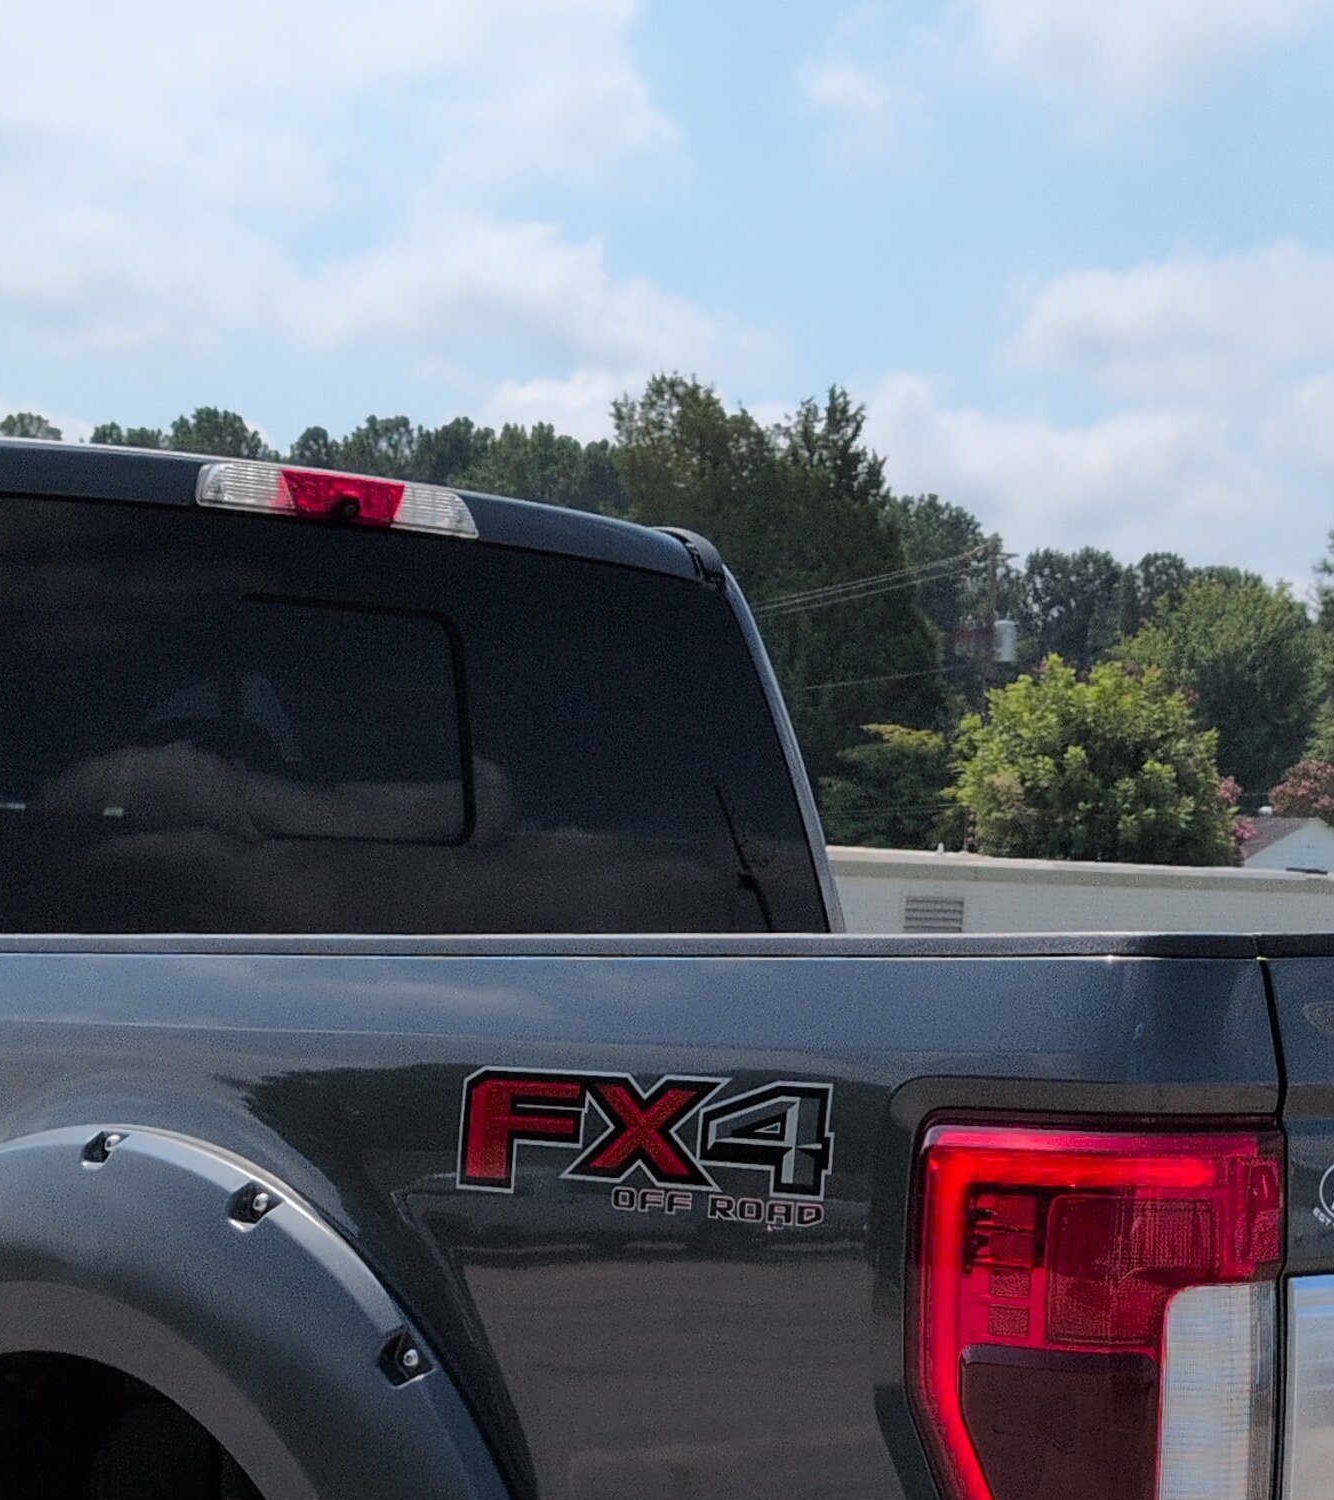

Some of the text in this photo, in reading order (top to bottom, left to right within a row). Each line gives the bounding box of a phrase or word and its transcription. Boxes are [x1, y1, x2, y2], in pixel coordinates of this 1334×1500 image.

[456, 1066, 833, 1200] FX4
[610, 1186, 825, 1227] OFF ROAD
